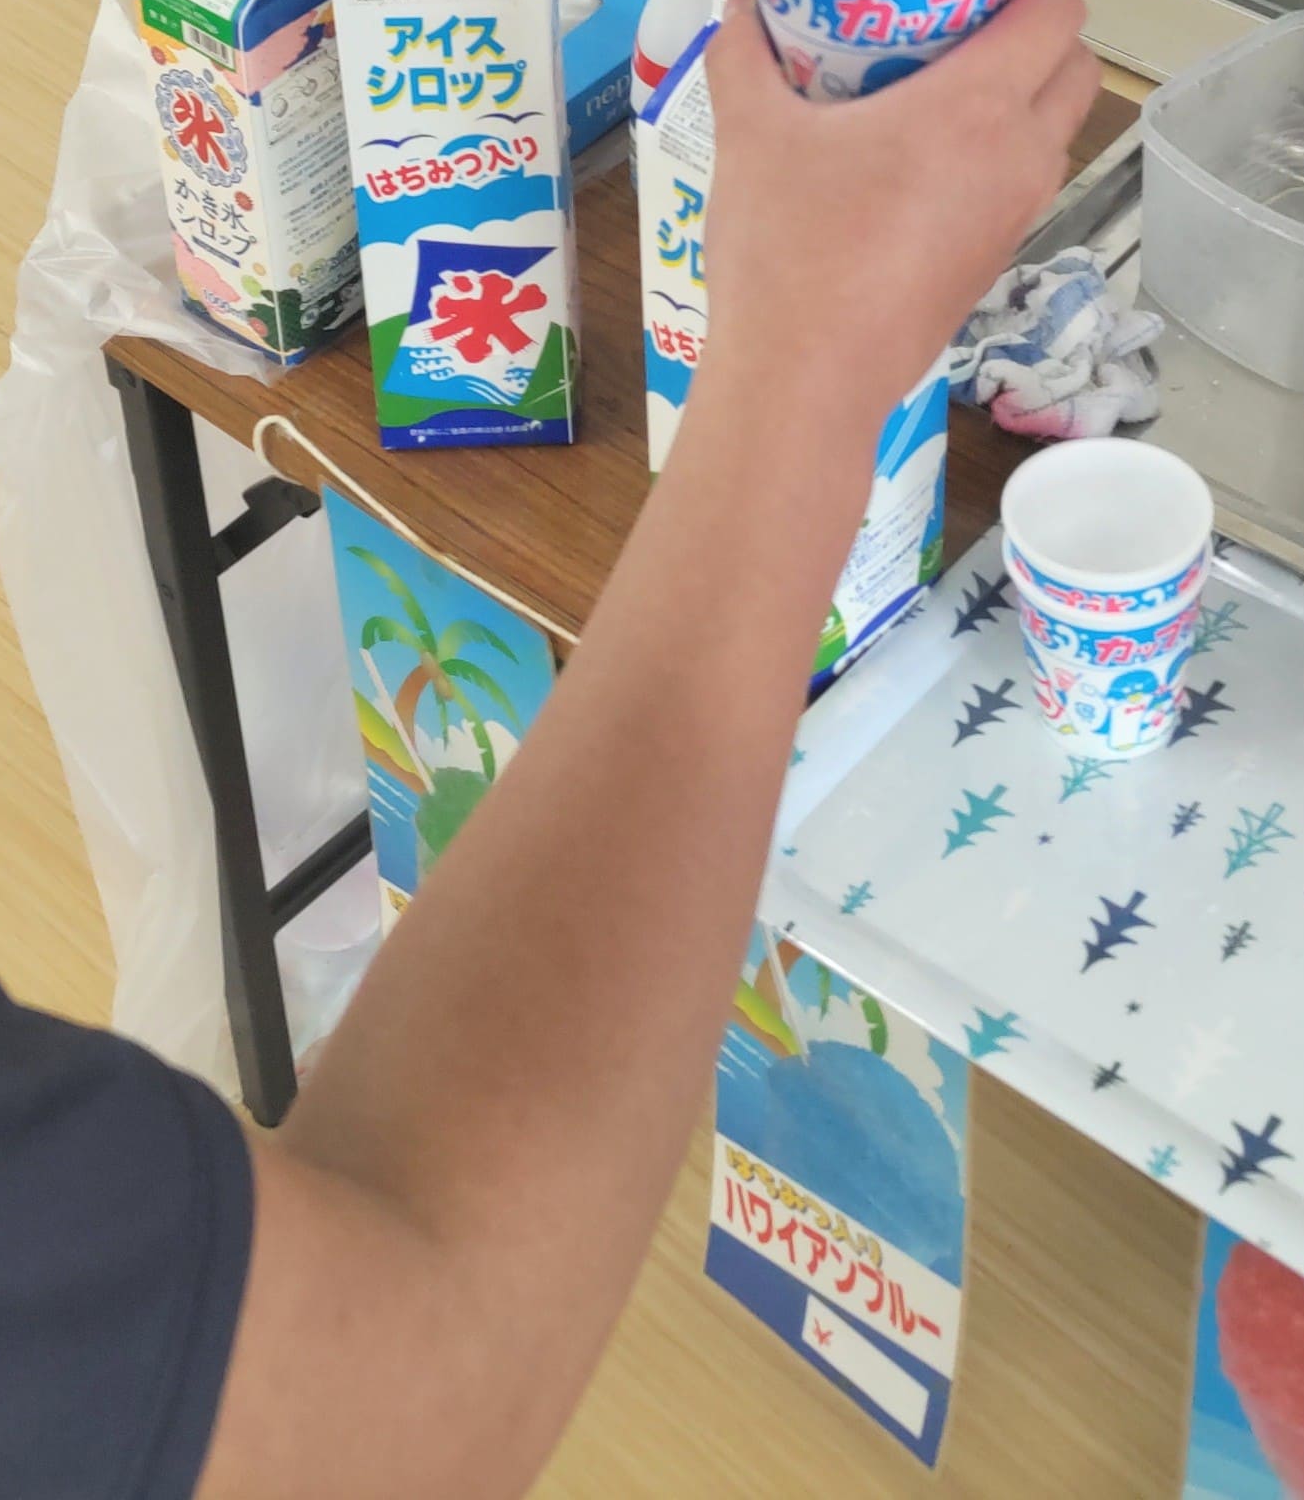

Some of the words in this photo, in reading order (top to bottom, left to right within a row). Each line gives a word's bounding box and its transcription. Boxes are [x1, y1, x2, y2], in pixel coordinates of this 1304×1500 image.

[383, 14, 506, 63] アイス
[366, 59, 527, 113] シロップ
[585, 75, 632, 118] nep
[172, 88, 232, 173] 氷
[366, 135, 539, 198] はちみつ入り
[174, 178, 251, 233] かき氷
[176, 203, 258, 256] シロップ
[426, 272, 548, 365] 氷
[652, 319, 706, 364] はち
[725, 1144, 883, 1268] はちみつ入り
[725, 1176, 942, 1338] ハワイアンブルー
